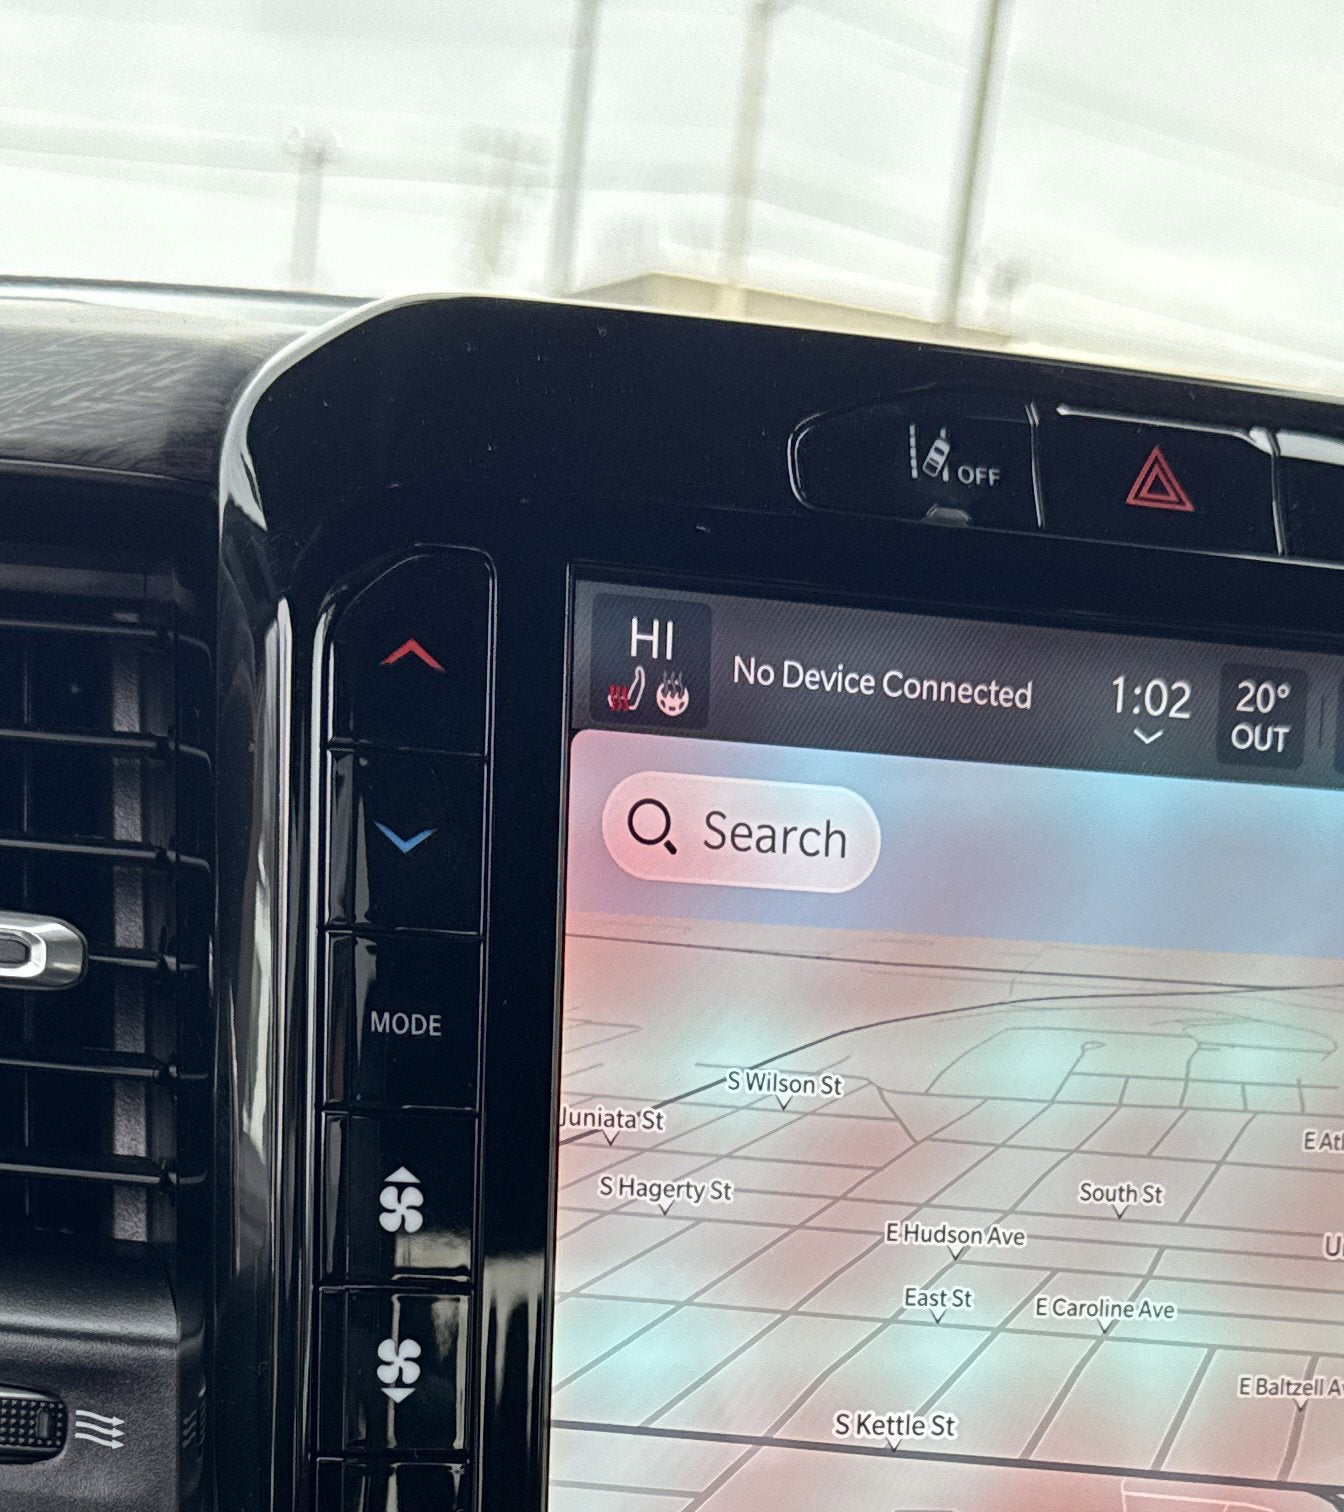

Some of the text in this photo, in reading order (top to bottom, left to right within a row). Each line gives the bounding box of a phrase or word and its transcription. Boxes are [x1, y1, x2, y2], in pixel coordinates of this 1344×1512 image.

[957, 465, 1002, 489] OFF
[630, 616, 674, 660] HI
[733, 655, 1034, 710] No Device Connected
[1112, 676, 1192, 719] 1:02
[1231, 722, 1290, 754] OUT
[703, 810, 848, 859] Search
[370, 1011, 443, 1037] MODE
[727, 1071, 843, 1097] S Wilson St
[559, 1106, 664, 1131] Juniata St
[1304, 1132, 1316, 1151] E
[599, 1177, 732, 1206] S Hagerty St
[1079, 1183, 1164, 1205] South St
[886, 1223, 1026, 1247] E Hudson Ave
[905, 1289, 973, 1310] East St
[1036, 1298, 1175, 1320] E Caroline Ave
[1239, 1378, 1251, 1395] E
[1256, 1378, 1324, 1397] Baltzell
[836, 1413, 955, 1437] S Kettle St
